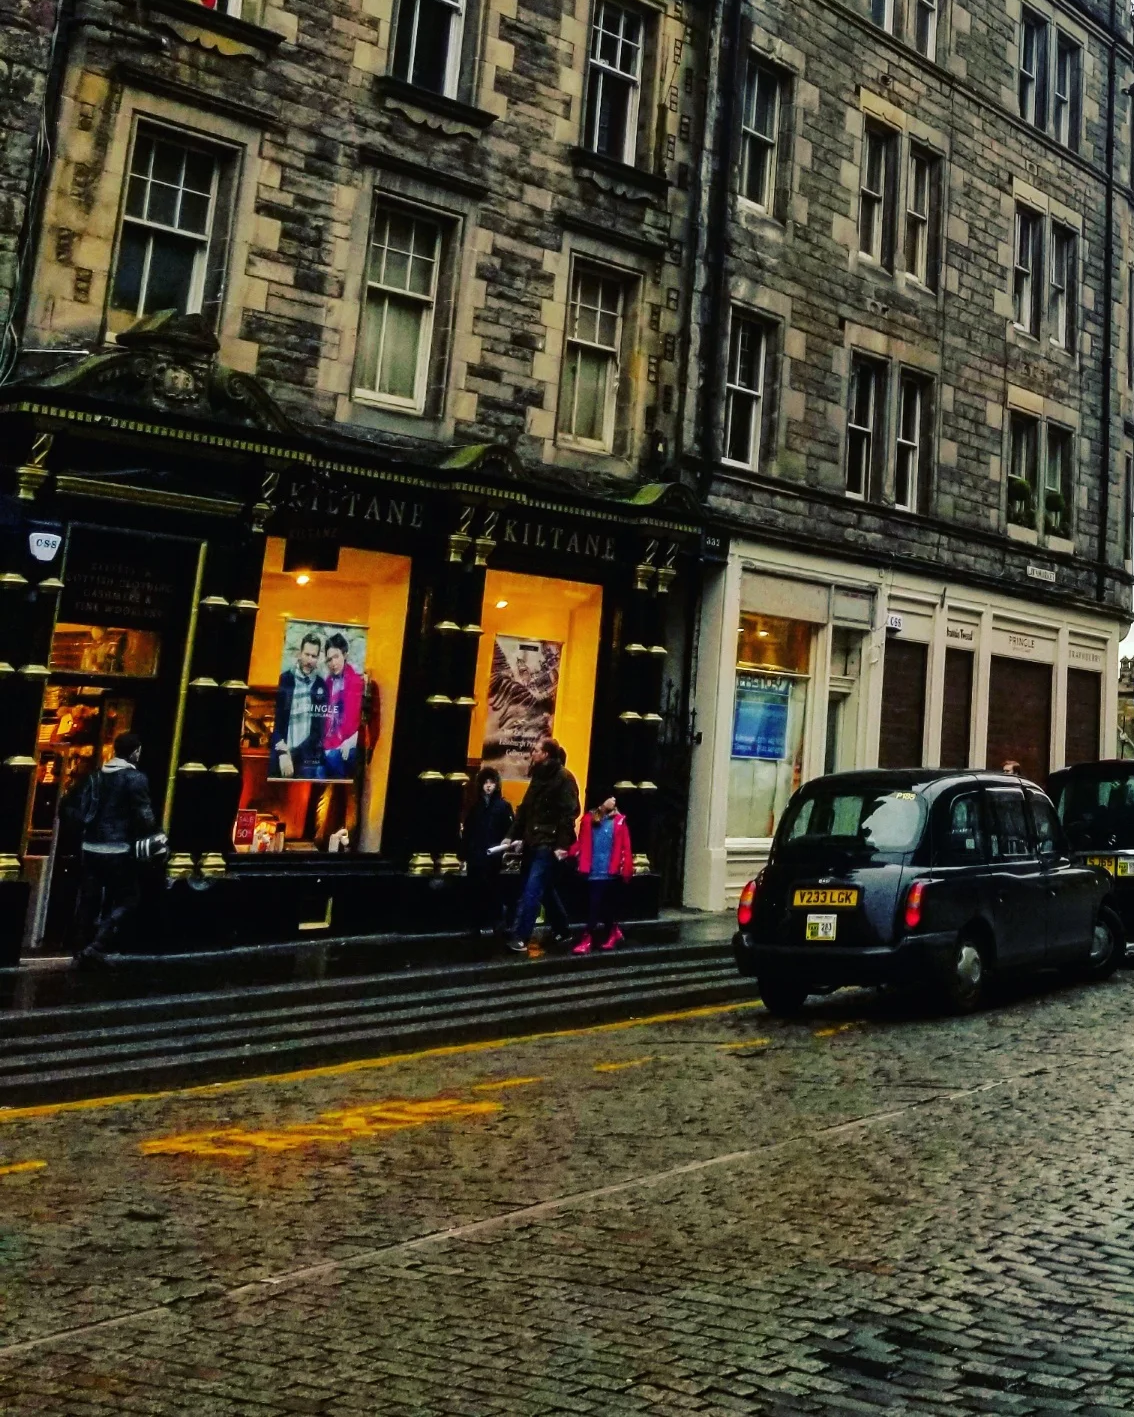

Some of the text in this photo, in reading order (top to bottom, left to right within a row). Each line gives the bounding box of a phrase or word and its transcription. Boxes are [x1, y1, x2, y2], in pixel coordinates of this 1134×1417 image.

[288, 483, 426, 529] KILTANE
[504, 519, 616, 561] KILTANE
[1008, 635, 1035, 649] PRINGLE
[800, 891, 853, 904] V233 LGK
